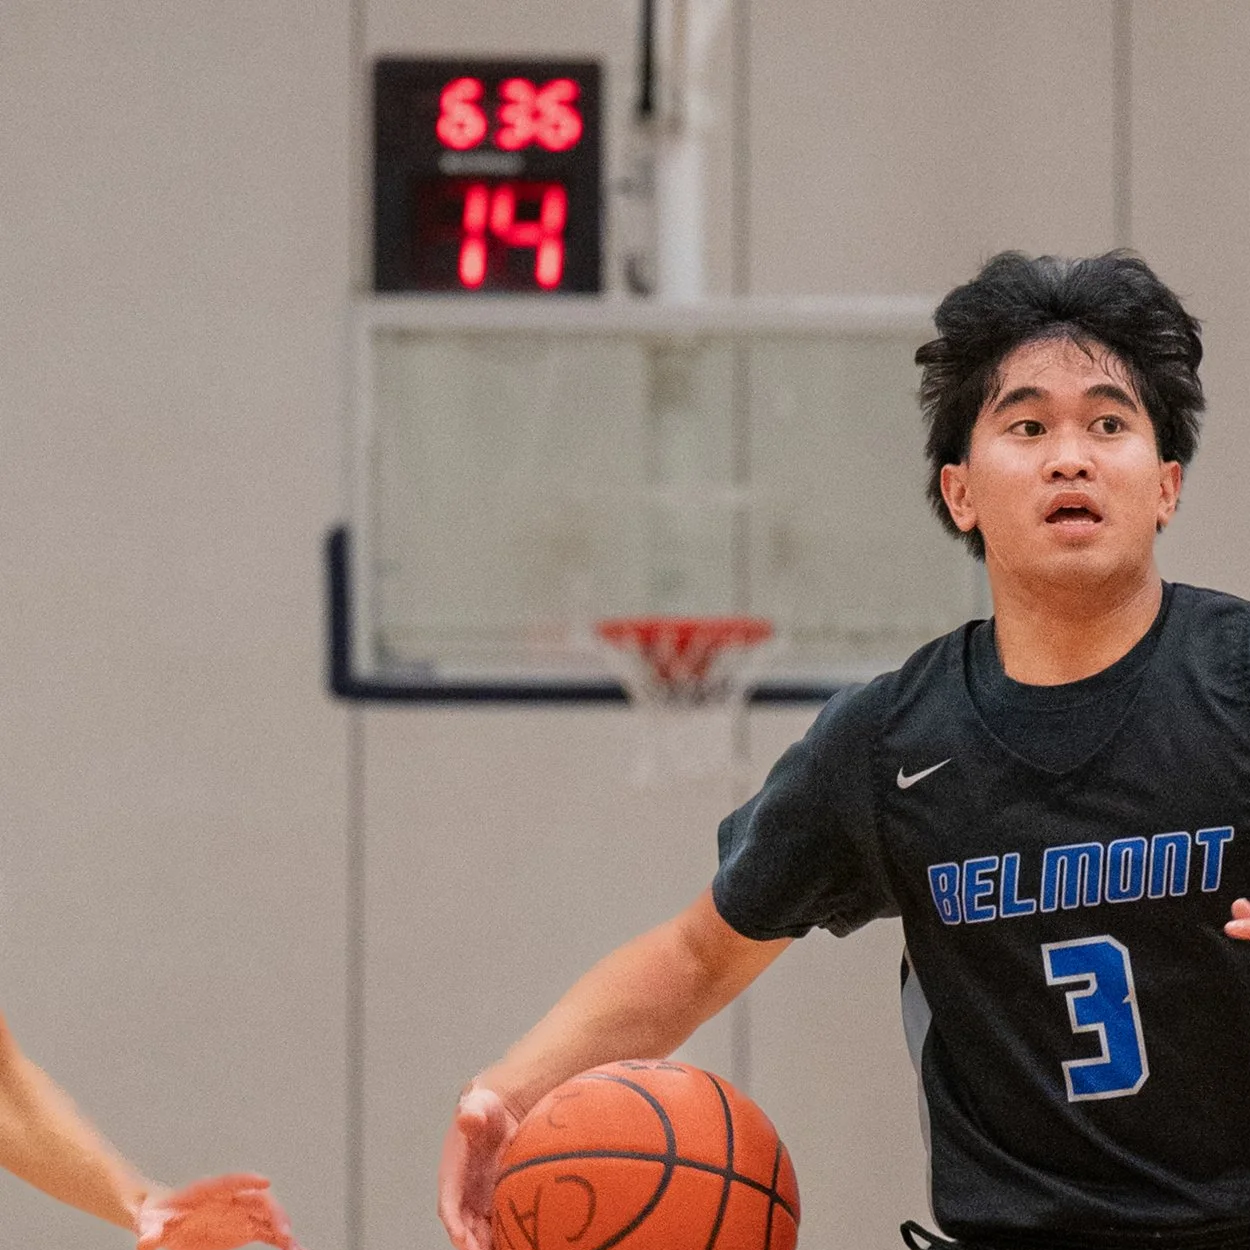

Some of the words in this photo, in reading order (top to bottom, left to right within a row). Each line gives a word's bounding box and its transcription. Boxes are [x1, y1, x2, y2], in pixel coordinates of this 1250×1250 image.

[457, 182, 568, 290] 14
[927, 826, 1234, 925] BELMONT
[1041, 934, 1150, 1102] 3
